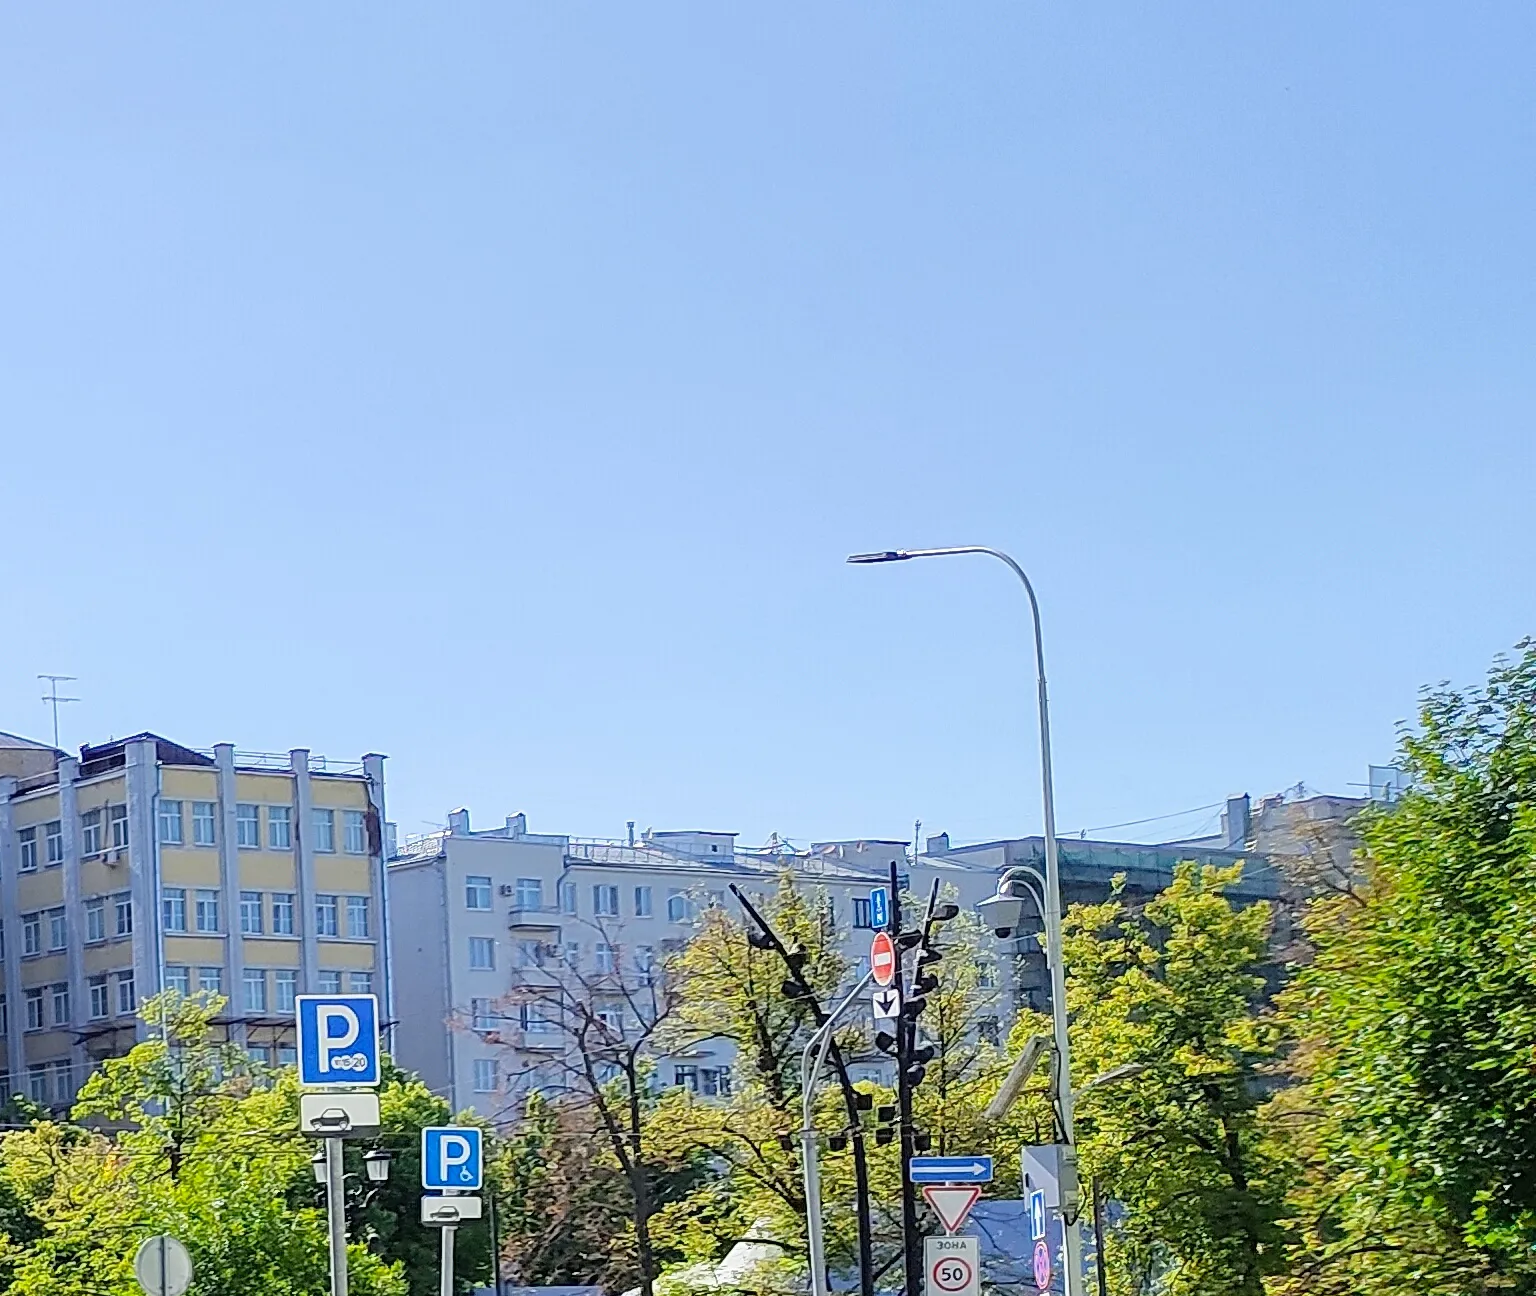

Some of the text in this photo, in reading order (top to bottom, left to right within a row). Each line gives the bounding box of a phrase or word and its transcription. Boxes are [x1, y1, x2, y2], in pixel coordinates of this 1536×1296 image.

[316, 1004, 360, 1073] P
[352, 1057, 366, 1068] 20
[439, 1134, 471, 1182] P
[936, 1240, 967, 1250] ЗОНА
[941, 1267, 964, 1282] 50
